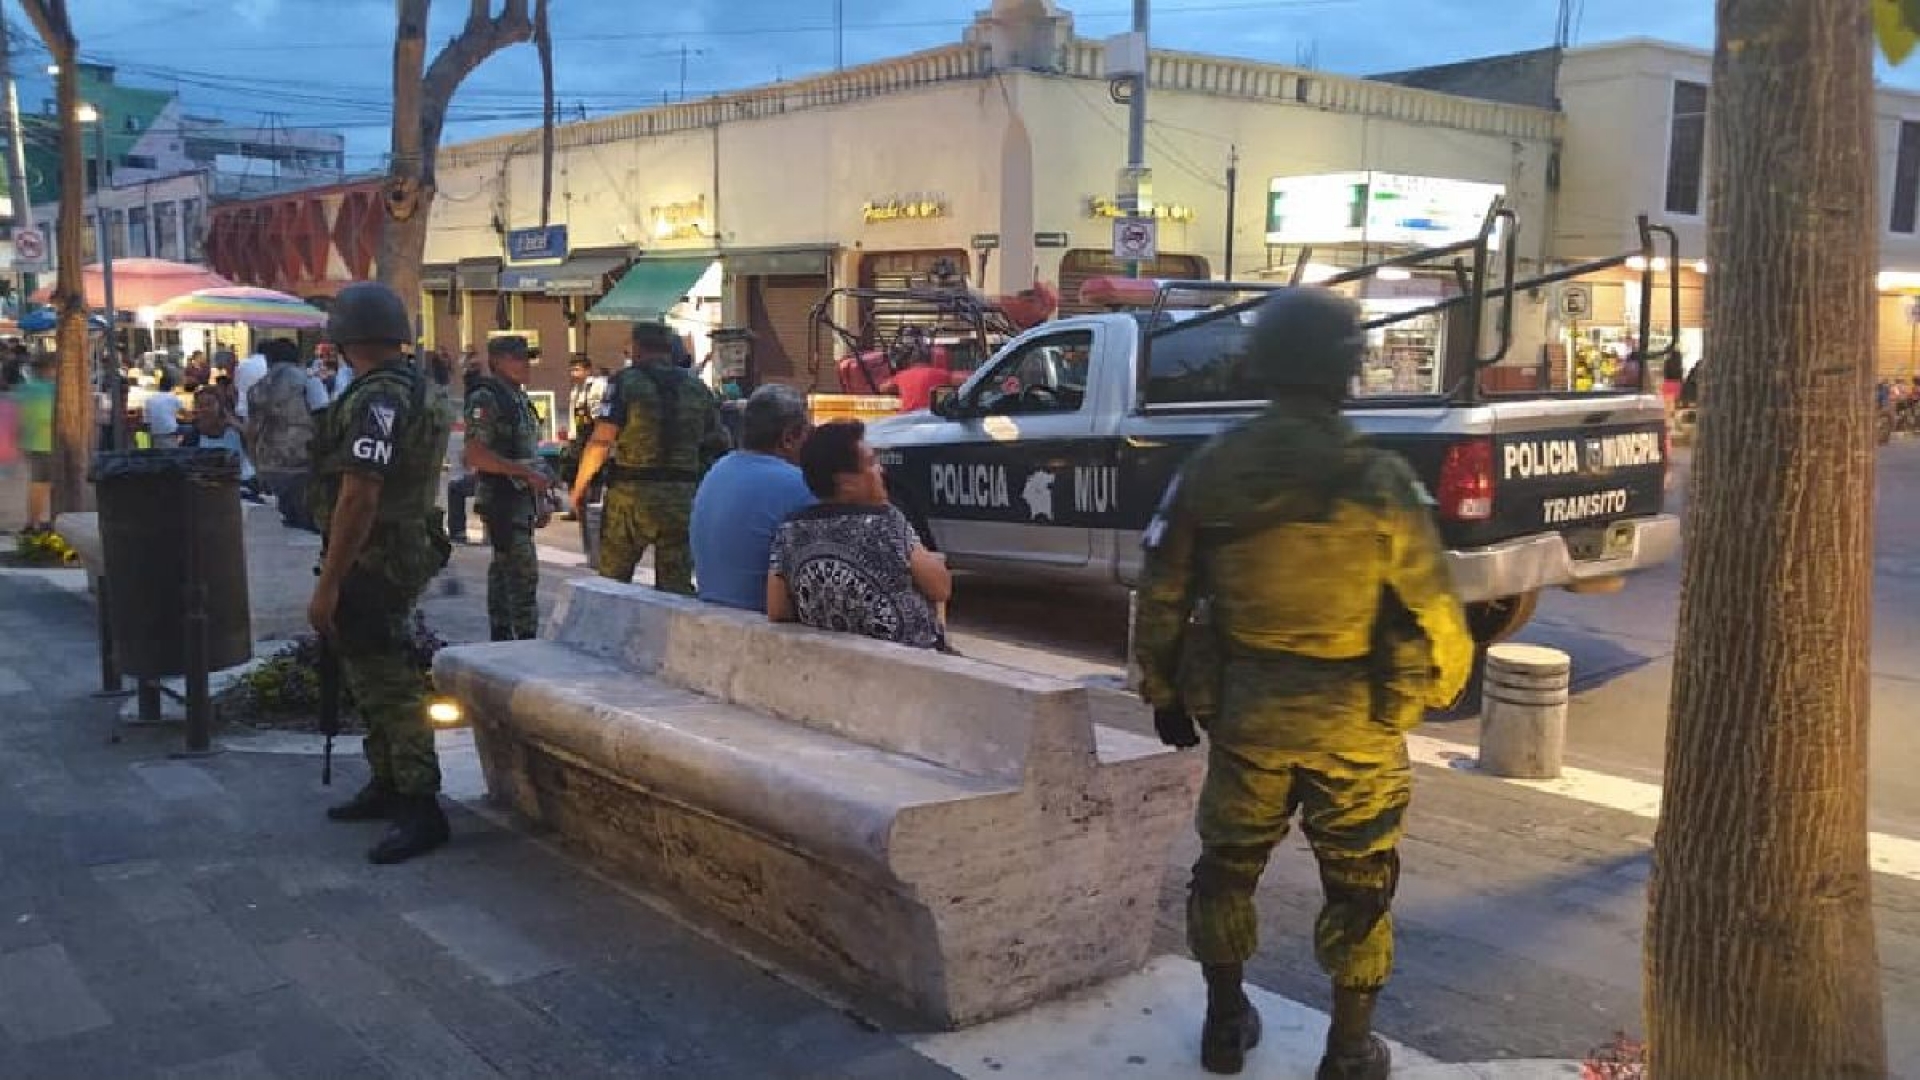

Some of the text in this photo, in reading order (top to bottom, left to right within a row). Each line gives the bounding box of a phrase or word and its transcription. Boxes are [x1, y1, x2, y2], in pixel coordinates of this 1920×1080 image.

[352, 435, 393, 465] GN
[1503, 439, 1580, 480] POLICIA
[931, 463, 1009, 507] POLICIA
[1543, 488, 1627, 524] TRANSITO
